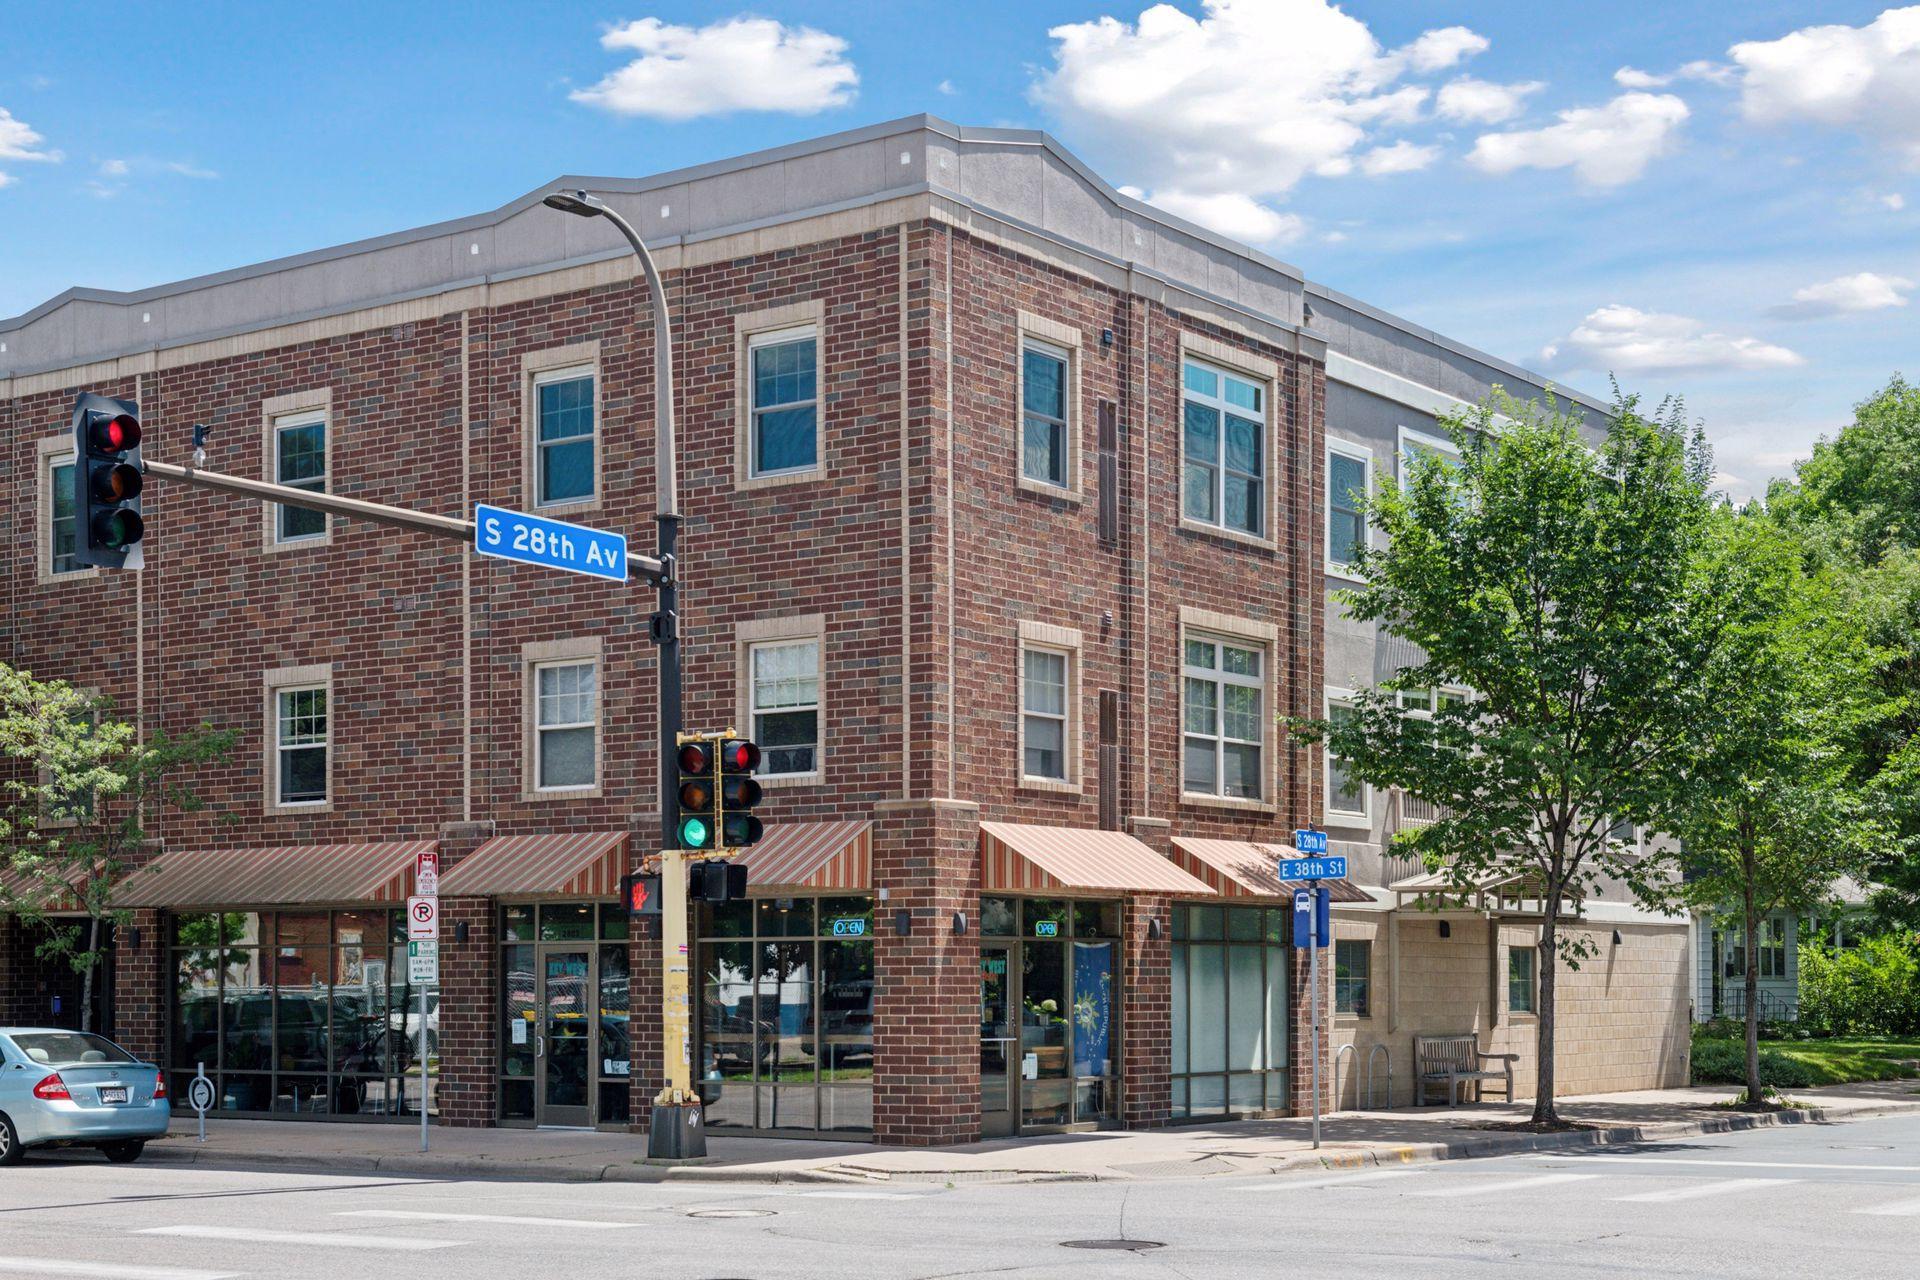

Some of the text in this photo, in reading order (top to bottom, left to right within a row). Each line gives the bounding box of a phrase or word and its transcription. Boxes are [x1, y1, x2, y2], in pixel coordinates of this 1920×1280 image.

[485, 518, 618, 568] S 28th Av
[1297, 834, 1302, 848] S
[1303, 835, 1318, 849] 28th
[1282, 861, 1343, 877] E 38th St
[836, 922, 862, 934] OPEN
[1037, 923, 1056, 934] OPEN
